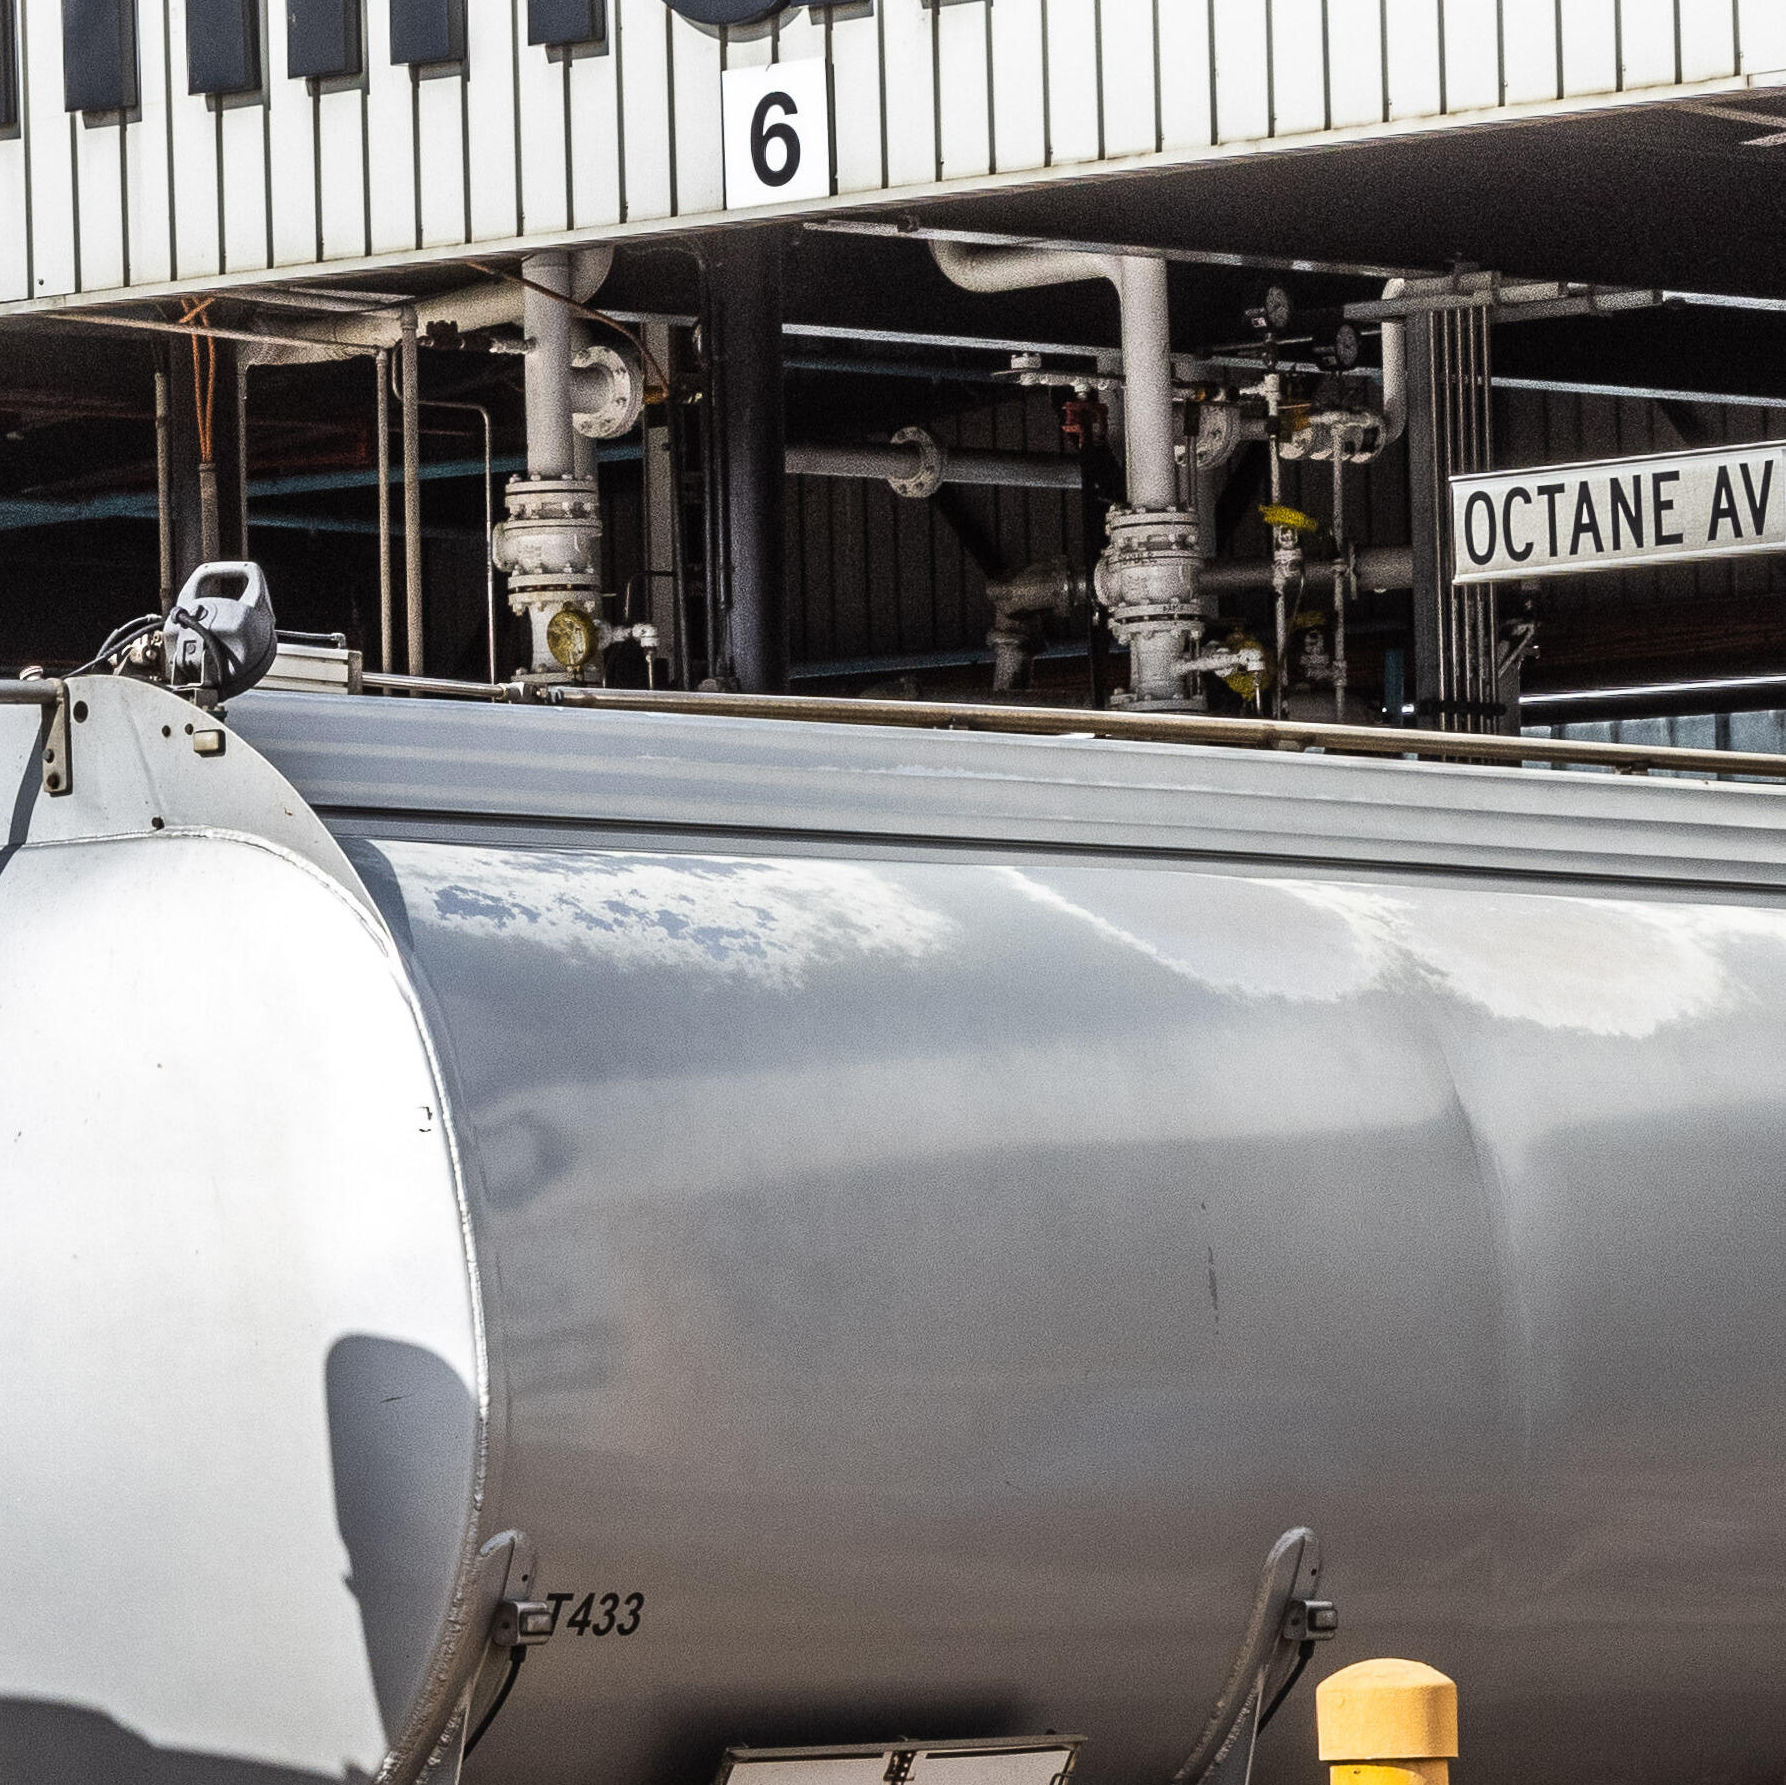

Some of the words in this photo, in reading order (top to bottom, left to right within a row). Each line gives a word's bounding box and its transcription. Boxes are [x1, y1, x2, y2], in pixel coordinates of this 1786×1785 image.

[750, 91, 800, 189] 6
[1463, 470, 1684, 565] OCTANE
[1708, 460, 1773, 542] AV
[546, 1592, 644, 1636] T433
